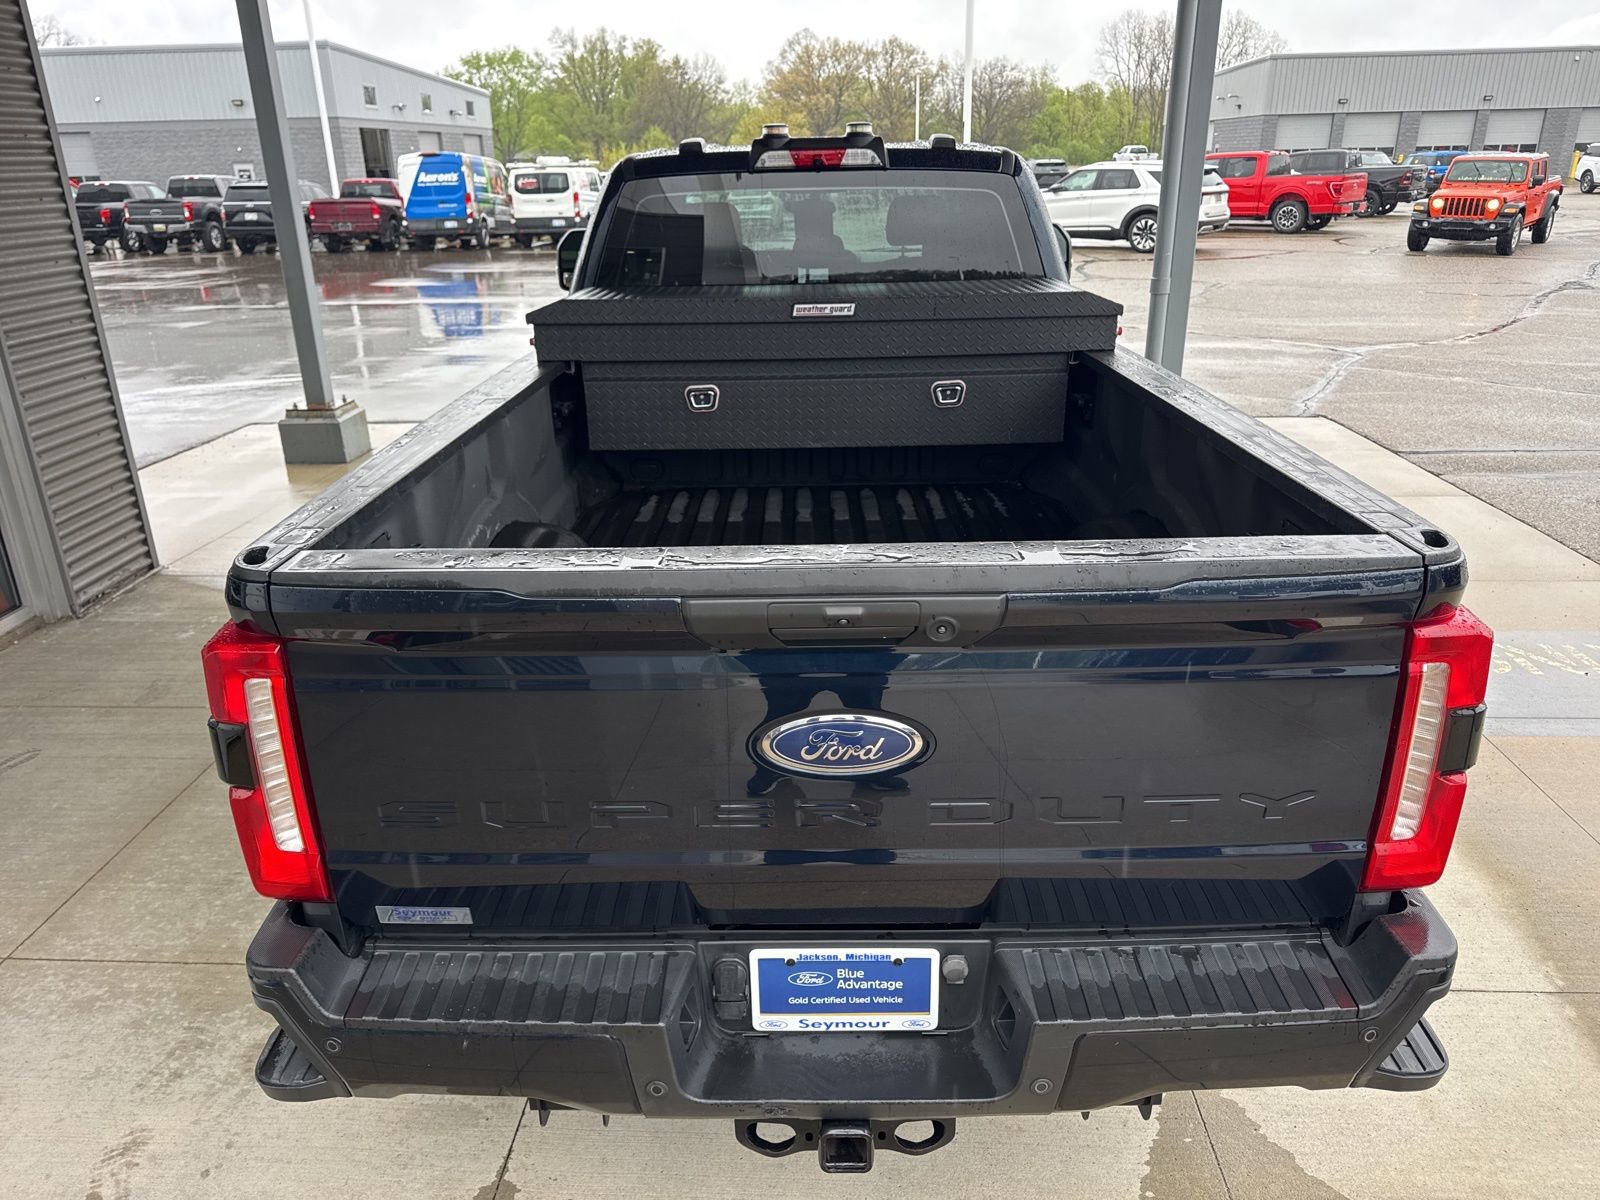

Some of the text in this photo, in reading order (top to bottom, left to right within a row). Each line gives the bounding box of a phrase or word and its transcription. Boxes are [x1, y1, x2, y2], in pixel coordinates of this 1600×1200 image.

[796, 305, 852, 314] weather guard
[801, 728, 885, 761] Ford
[377, 789, 1318, 829] SUPER DUTY
[394, 907, 452, 917] Seymour
[796, 953, 891, 961] Jackson, Michigan
[796, 972, 825, 985] Ford
[836, 968, 865, 979] Blue
[836, 979, 904, 991] Advantage
[788, 996, 904, 1005] Gold Certified Used Vehicle
[798, 1018, 891, 1030] Seymour
